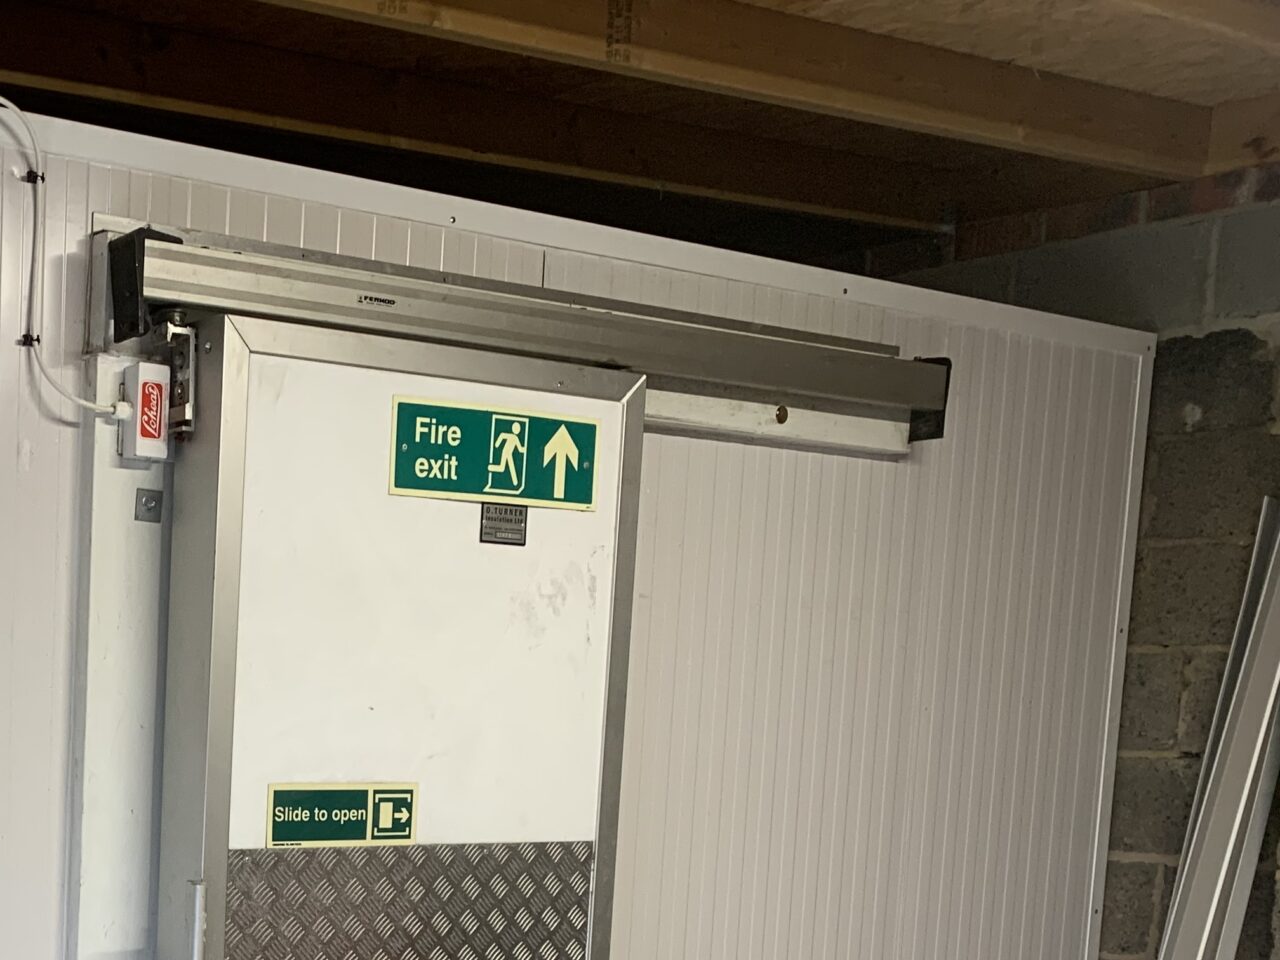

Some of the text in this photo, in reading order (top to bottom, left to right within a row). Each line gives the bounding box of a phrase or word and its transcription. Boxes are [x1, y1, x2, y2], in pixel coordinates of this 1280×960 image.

[414, 416, 462, 446] Fire
[414, 454, 459, 480] exit
[274, 806, 366, 824] Slide to open
